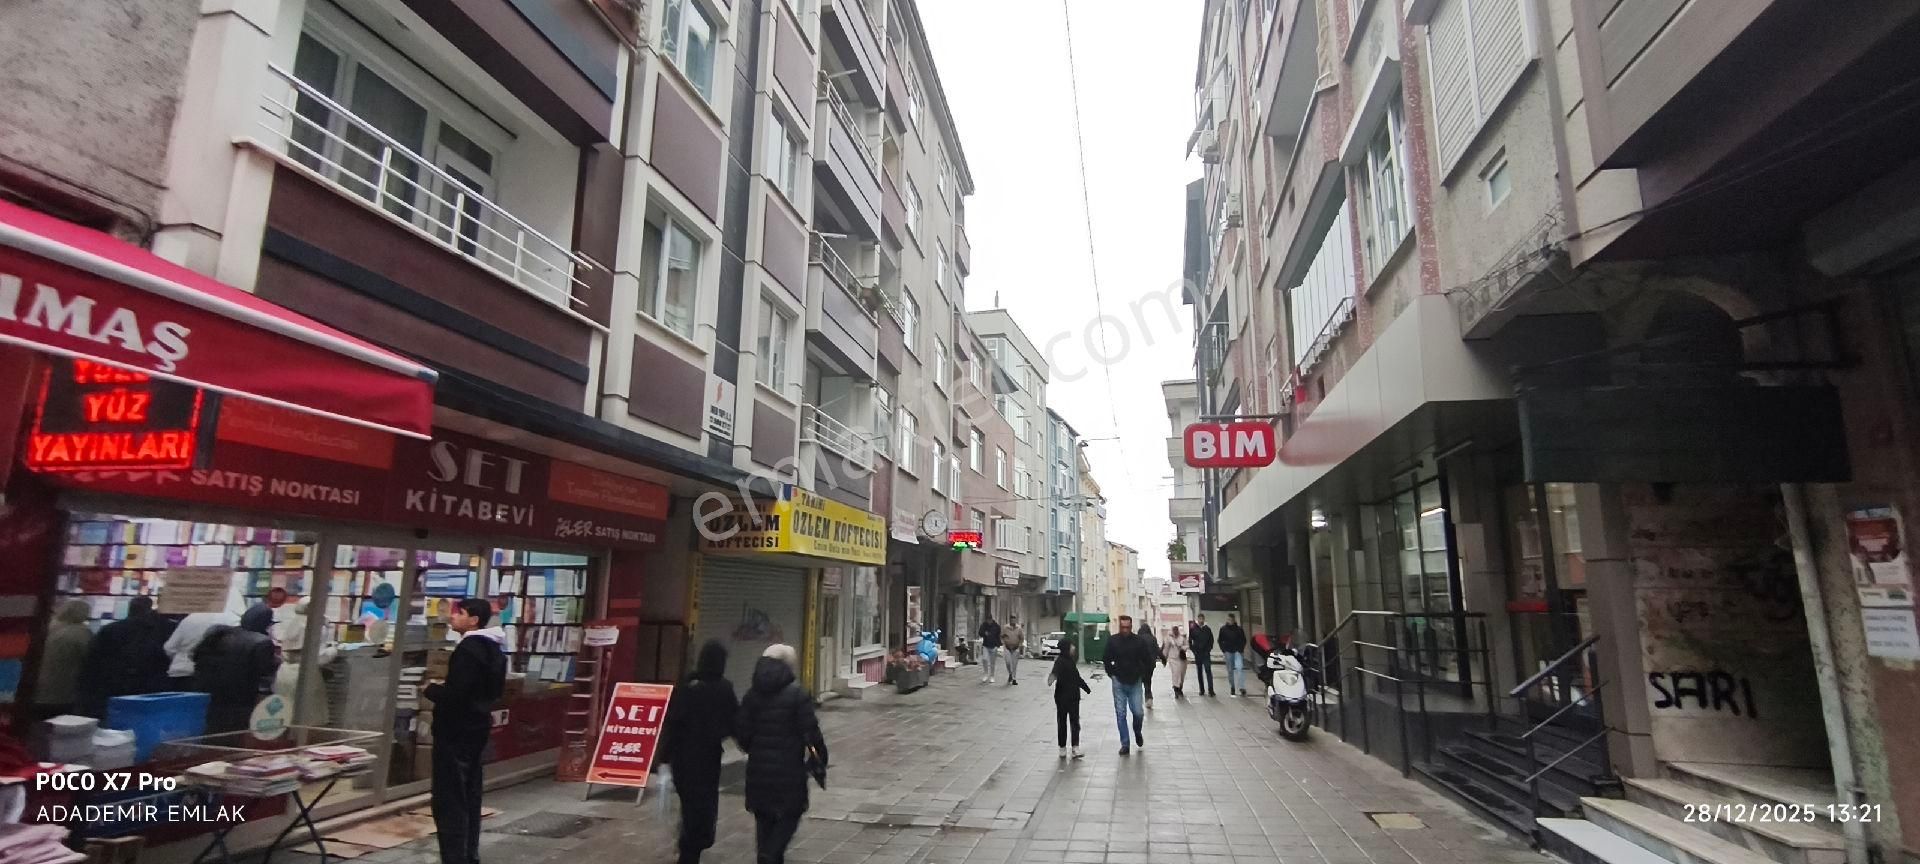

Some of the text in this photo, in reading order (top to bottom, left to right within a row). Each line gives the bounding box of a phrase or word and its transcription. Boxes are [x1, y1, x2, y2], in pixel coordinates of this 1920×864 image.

[87, 388, 146, 422] YÜZ
[33, 432, 191, 462] YAYINLARI
[1192, 424, 1267, 459] BİM
[427, 441, 530, 494] SET
[190, 469, 263, 497] SATIŞ
[270, 478, 360, 506] NOKTASI
[405, 487, 535, 528] KİTABEVİ
[606, 724, 658, 736] KİTABEVİ
